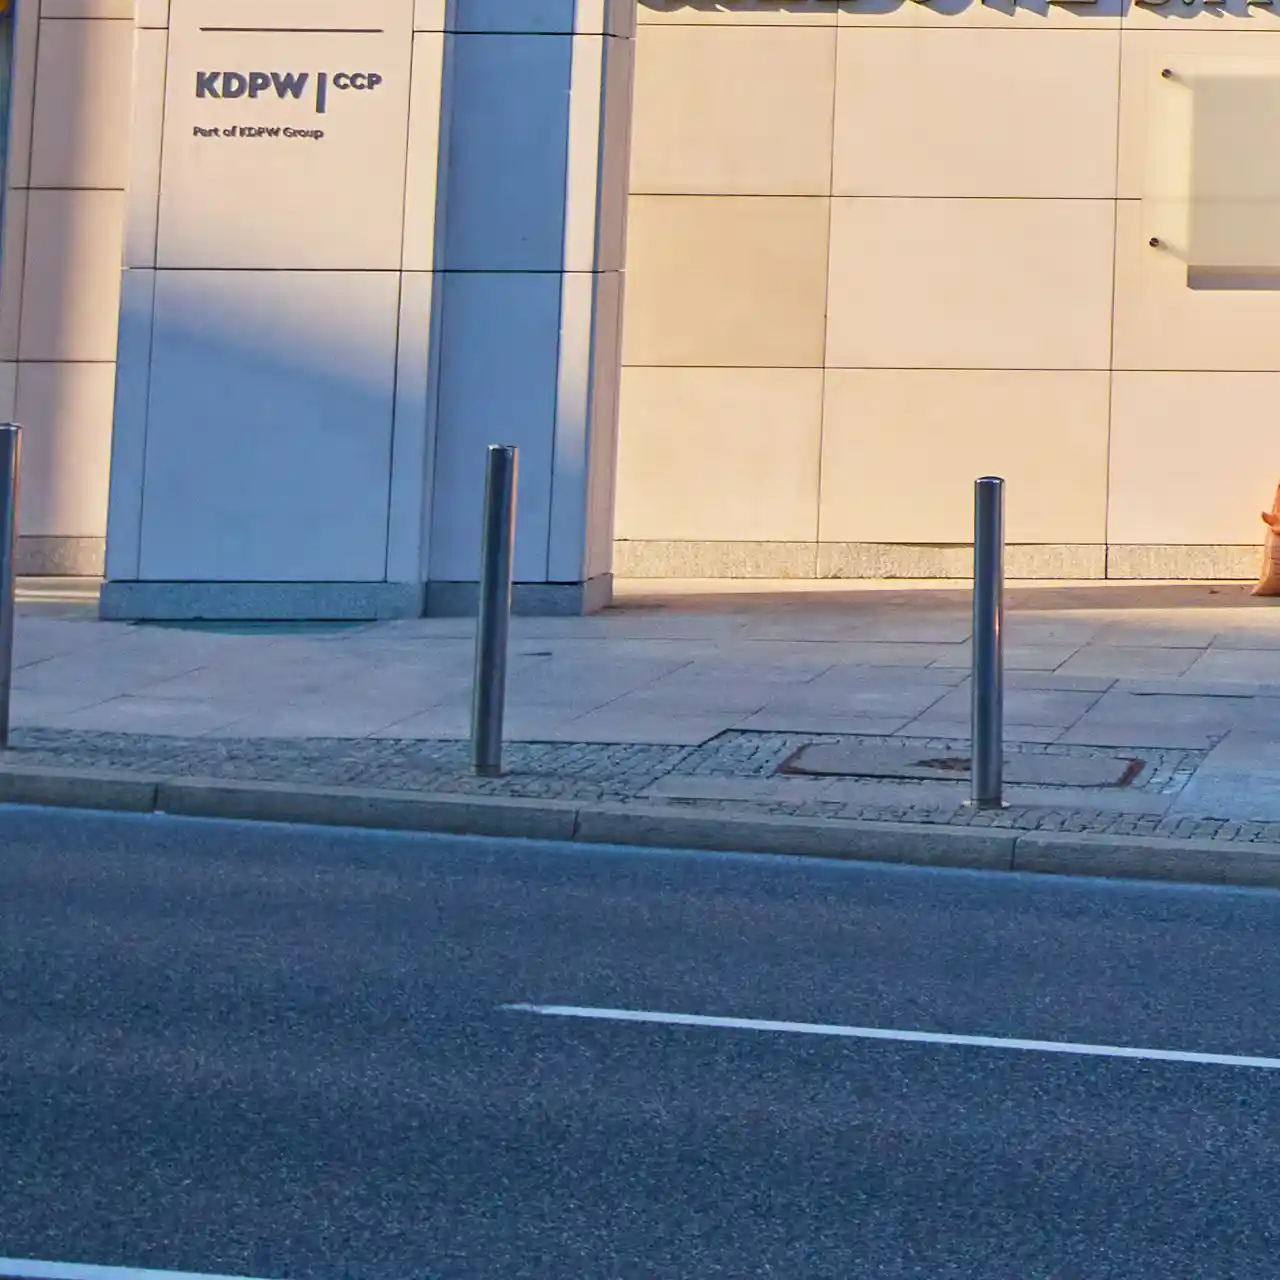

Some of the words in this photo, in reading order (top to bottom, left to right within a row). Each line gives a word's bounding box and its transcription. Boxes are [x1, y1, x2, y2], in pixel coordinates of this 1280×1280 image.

[195, 71, 309, 99] KDPW
[333, 72, 383, 90] CCP
[193, 126, 221, 138] Part
[223, 126, 237, 138] of
[283, 127, 325, 140] Group
